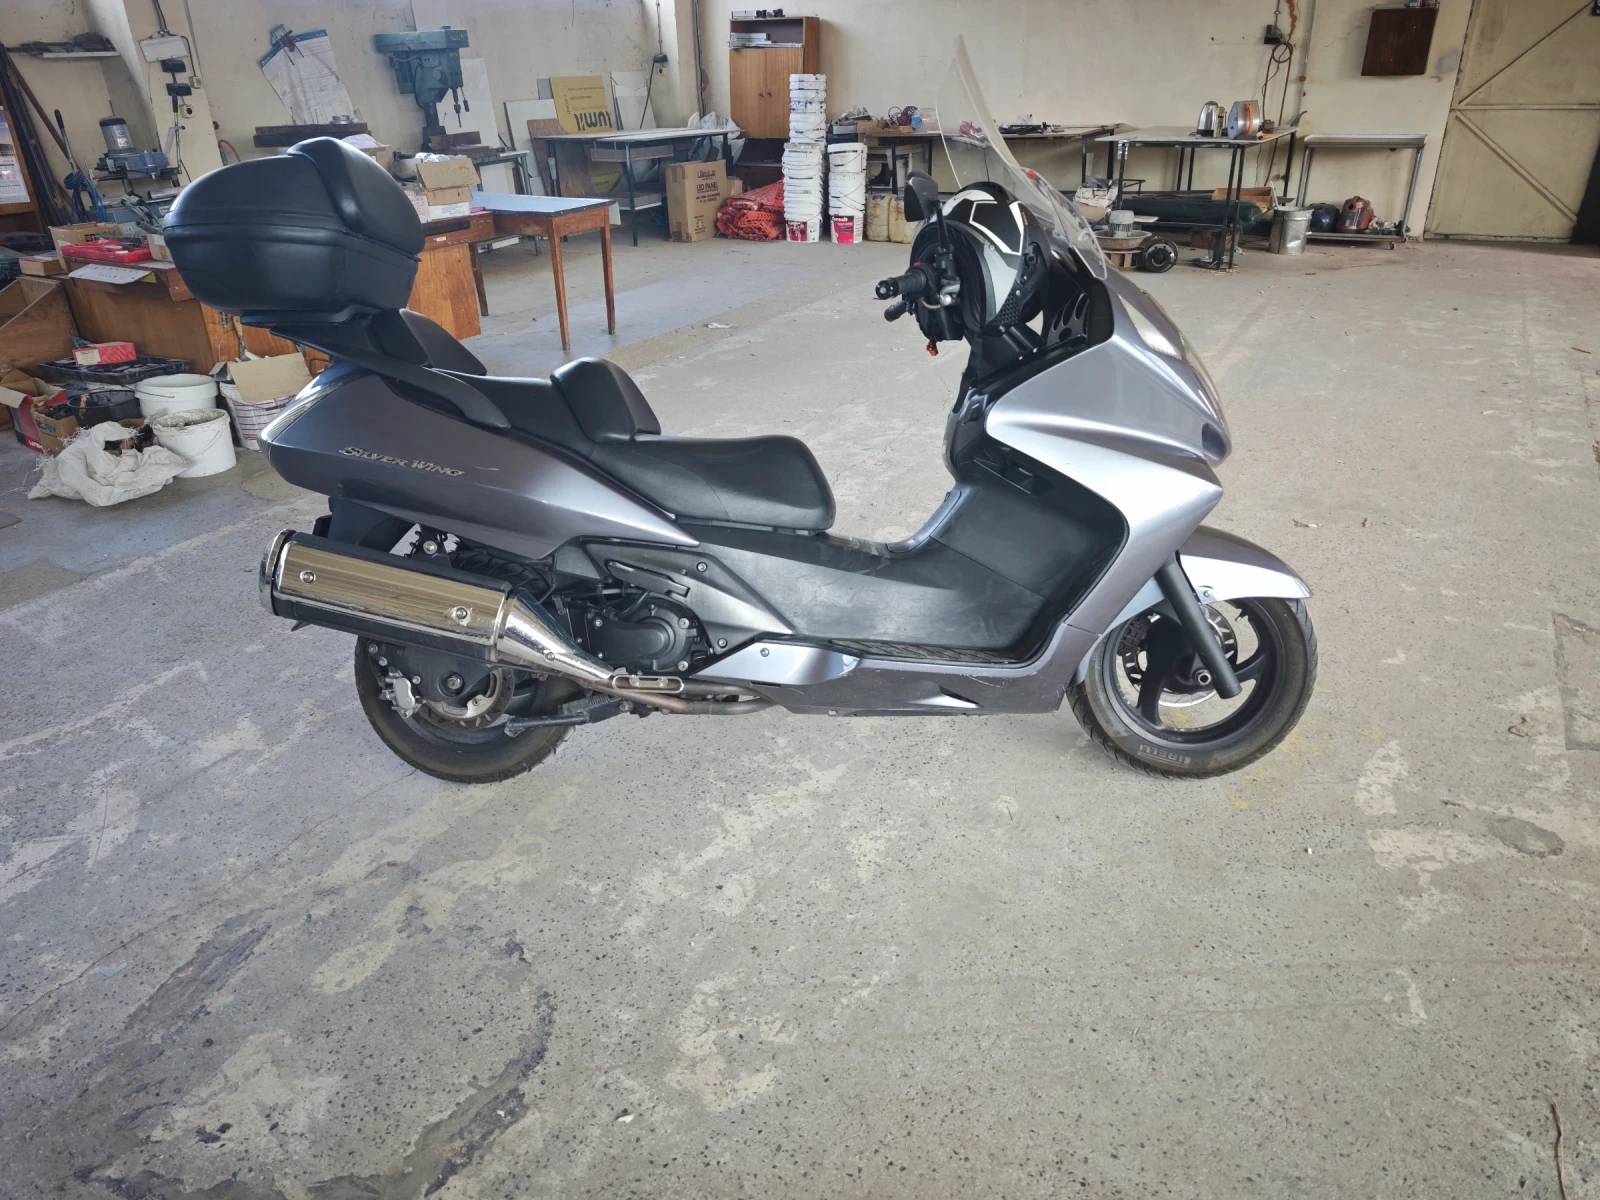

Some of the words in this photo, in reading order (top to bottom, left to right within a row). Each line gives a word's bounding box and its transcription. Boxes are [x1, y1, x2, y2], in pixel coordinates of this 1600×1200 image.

[697, 184, 705, 192] LED
[705, 181, 719, 190] PANEL
[1139, 744, 1191, 765] PIRELLI
